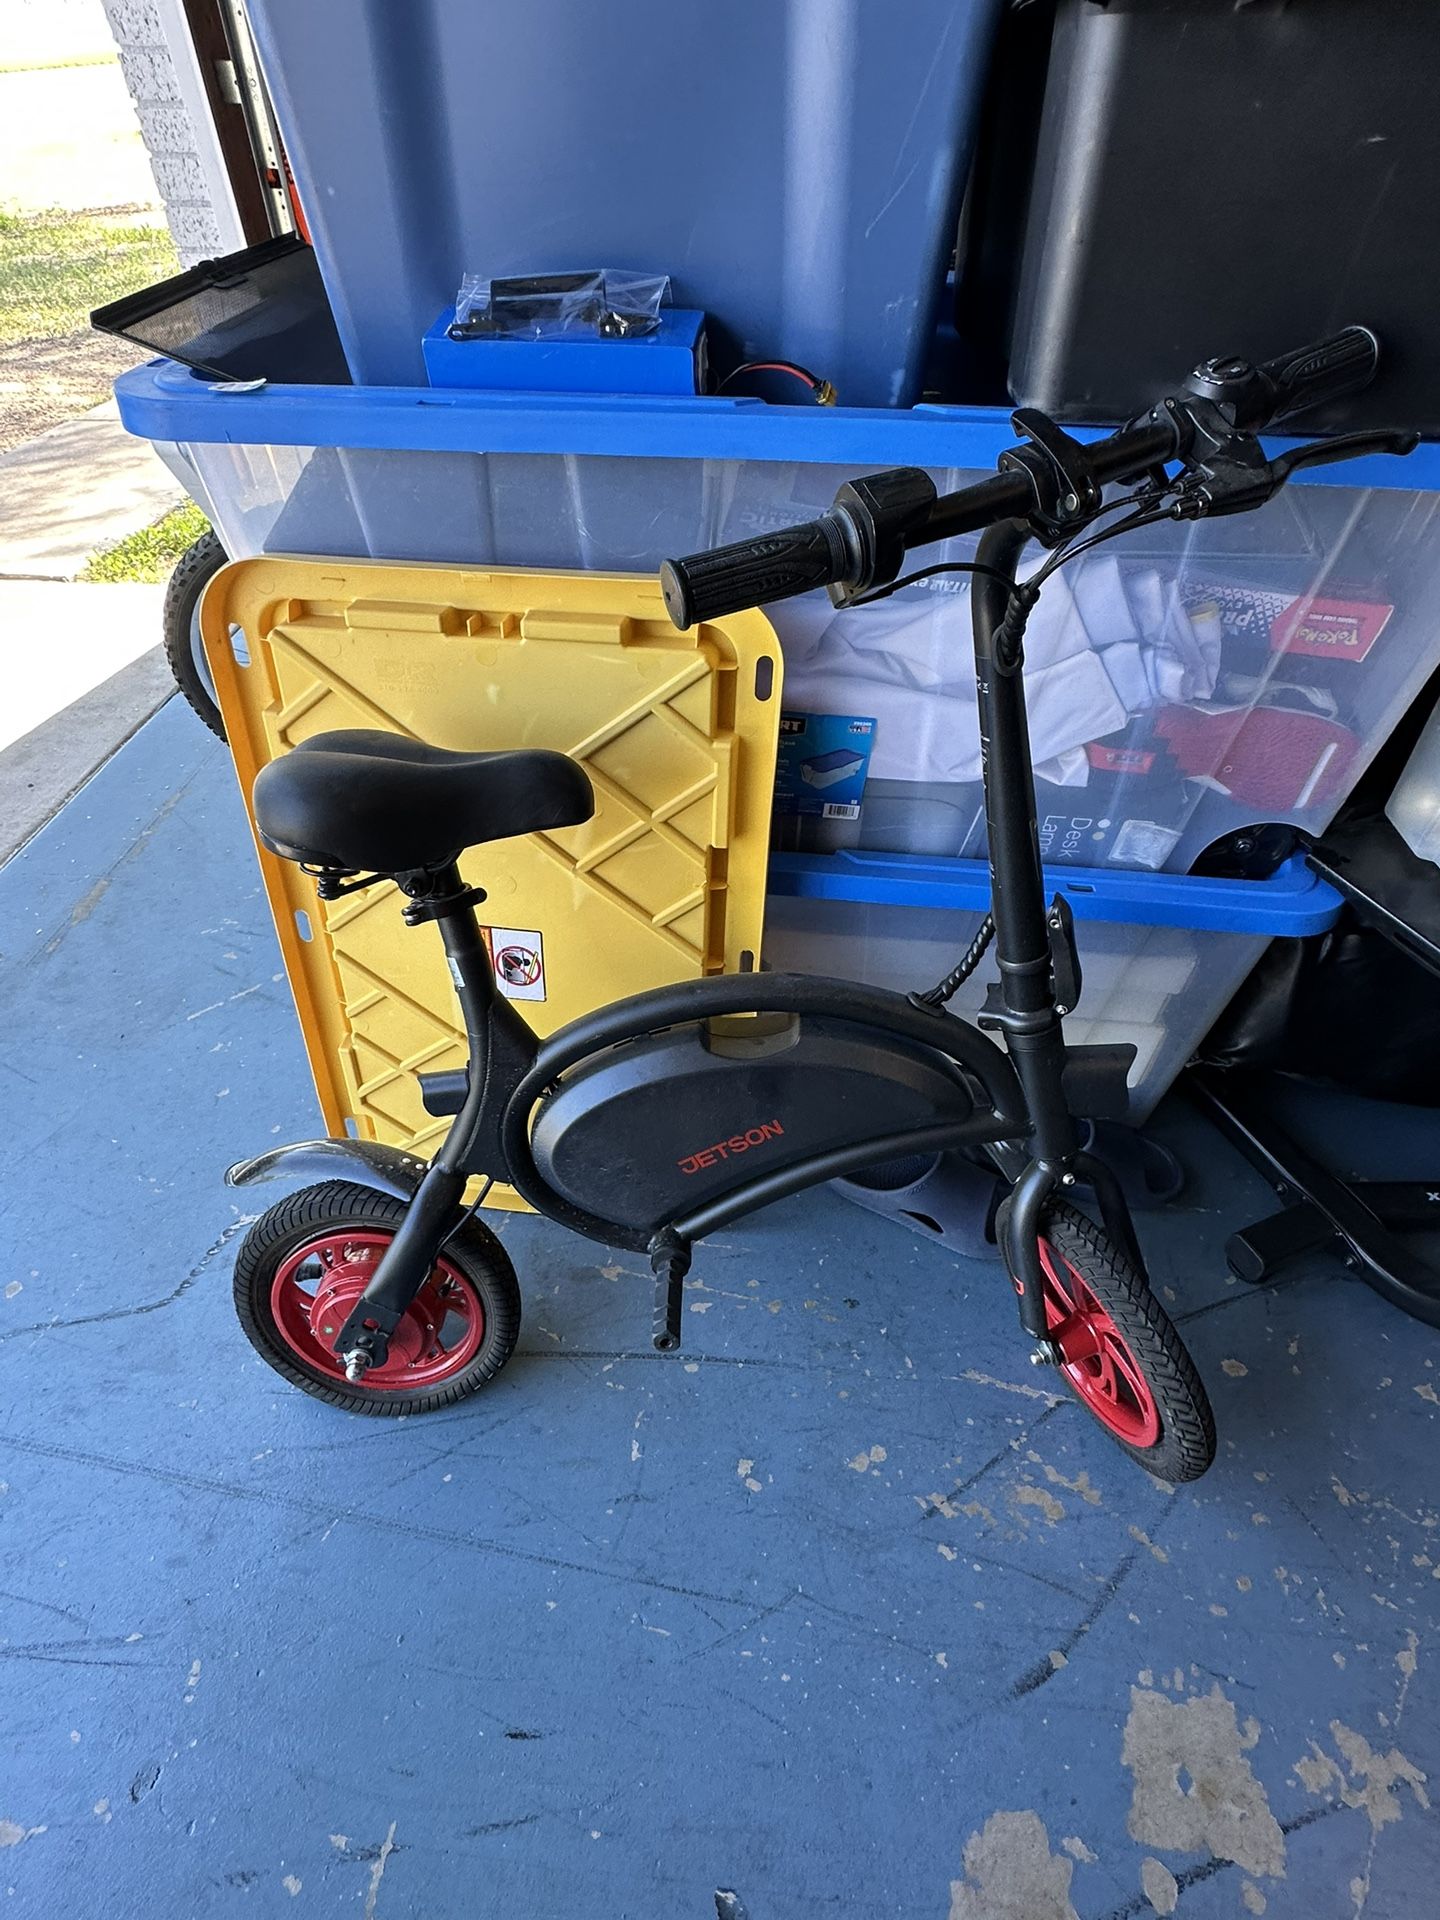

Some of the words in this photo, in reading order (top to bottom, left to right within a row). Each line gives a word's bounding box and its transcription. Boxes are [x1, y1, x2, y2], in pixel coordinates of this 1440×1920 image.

[1220, 599, 1244, 609] EVO
[1223, 609, 1255, 626] PR
[780, 720, 801, 732] RT
[1057, 817, 1093, 857] Desk
[677, 1119, 785, 1174] JETSON
